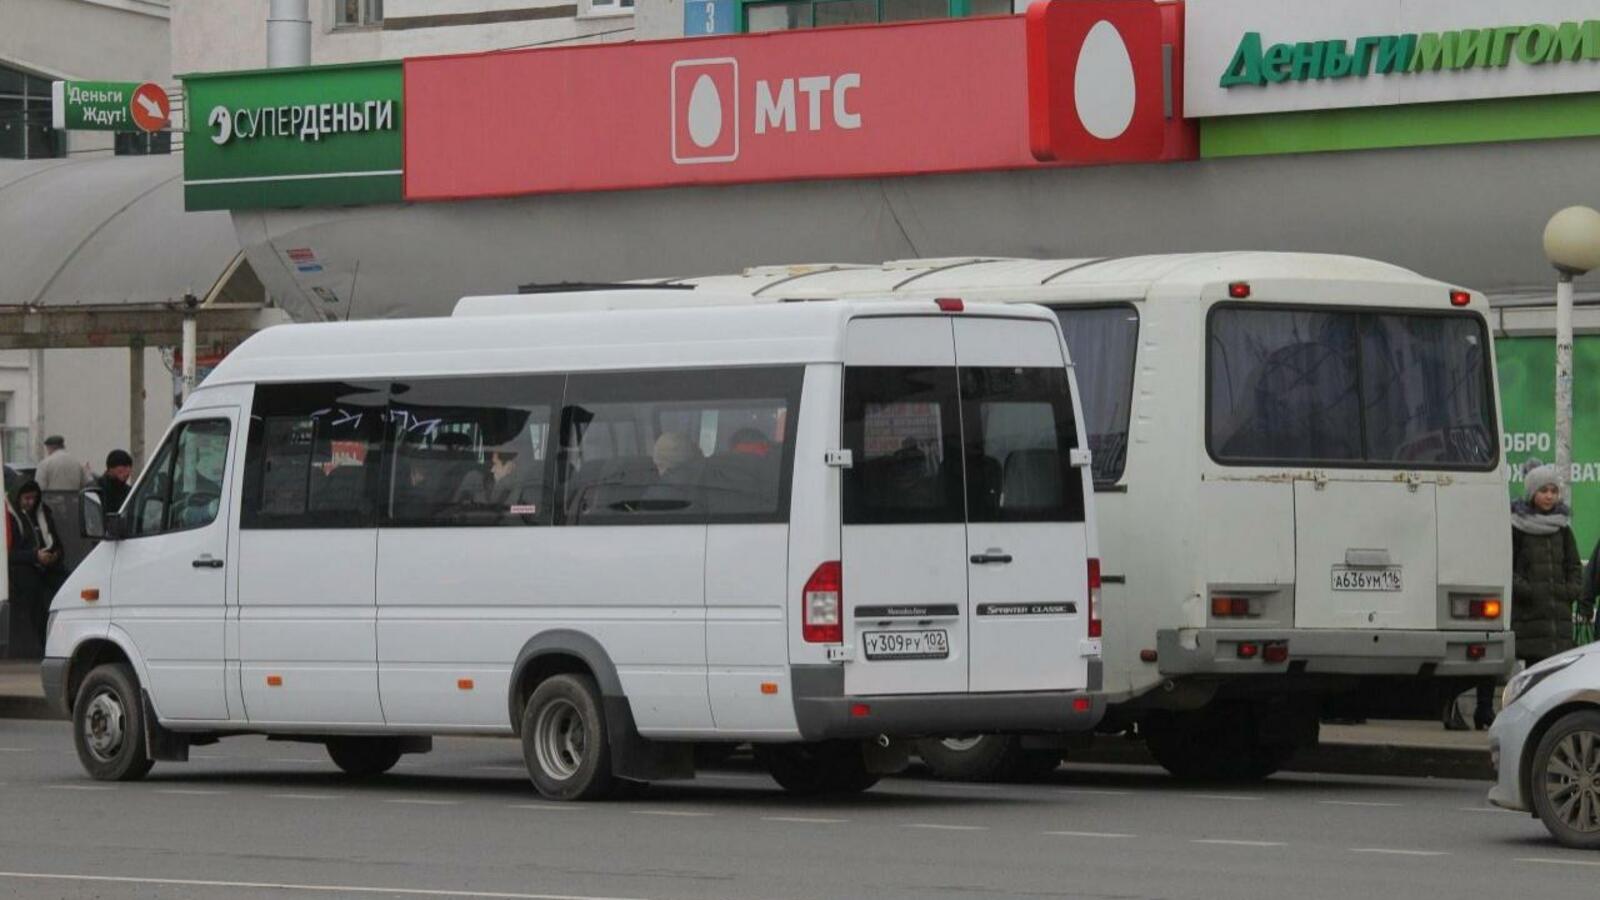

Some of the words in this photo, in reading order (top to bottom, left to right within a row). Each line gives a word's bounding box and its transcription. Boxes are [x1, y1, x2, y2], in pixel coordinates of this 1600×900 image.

[706, 2, 716, 34] 3
[69, 86, 123, 105] Деньги
[754, 72, 862, 135] МТС
[82, 106, 127, 125] Ждут!
[233, 99, 393, 142] СУПЕРДЕНЬГИ
[1504, 432, 1551, 453] ОБРО
[869, 634, 921, 653] У309РУ
[923, 632, 945, 647] 102
